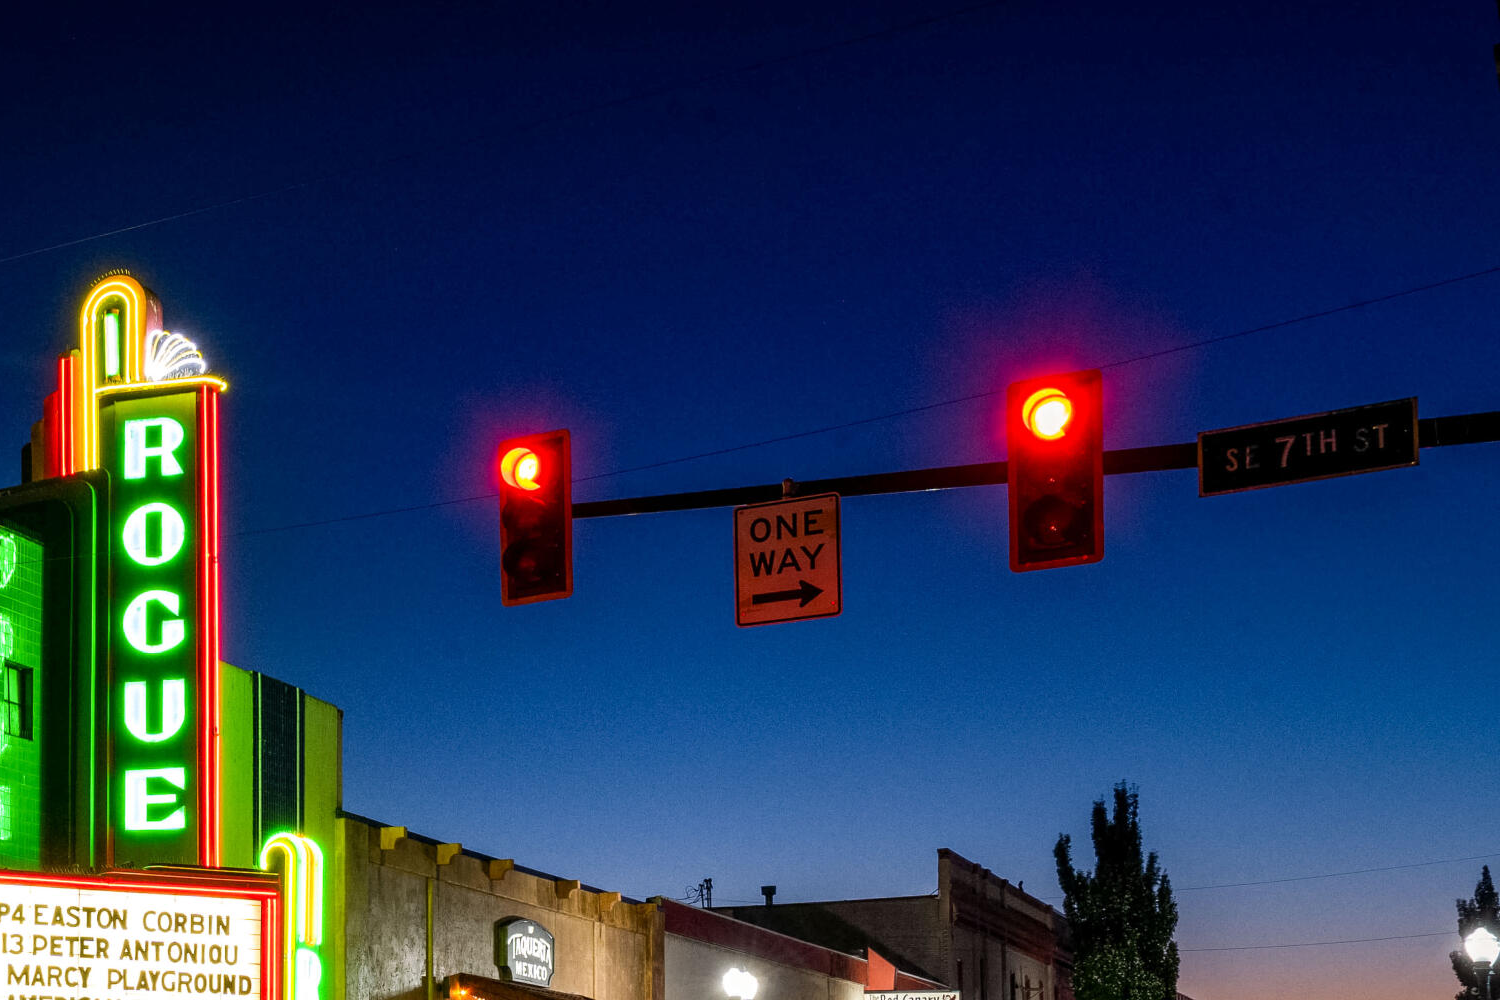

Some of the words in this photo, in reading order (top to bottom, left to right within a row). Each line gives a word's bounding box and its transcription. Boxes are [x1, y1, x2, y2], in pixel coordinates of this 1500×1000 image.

[1224, 444, 1260, 472] SE
[1275, 429, 1338, 468] 7TH
[1354, 423, 1389, 452] ST
[749, 509, 824, 542] ONE
[749, 544, 825, 577] WAY
[122, 417, 186, 831] ROGUE
[34, 904, 128, 930] EASTON
[143, 910, 230, 935] CORBIN
[33, 935, 109, 959] PETER
[120, 939, 238, 966] ANTONIOU
[508, 933, 552, 970] TAQUERIA
[7, 963, 92, 989] MARCY
[107, 969, 252, 995] PLAYGROUND
[515, 961, 548, 981] MEXICO
